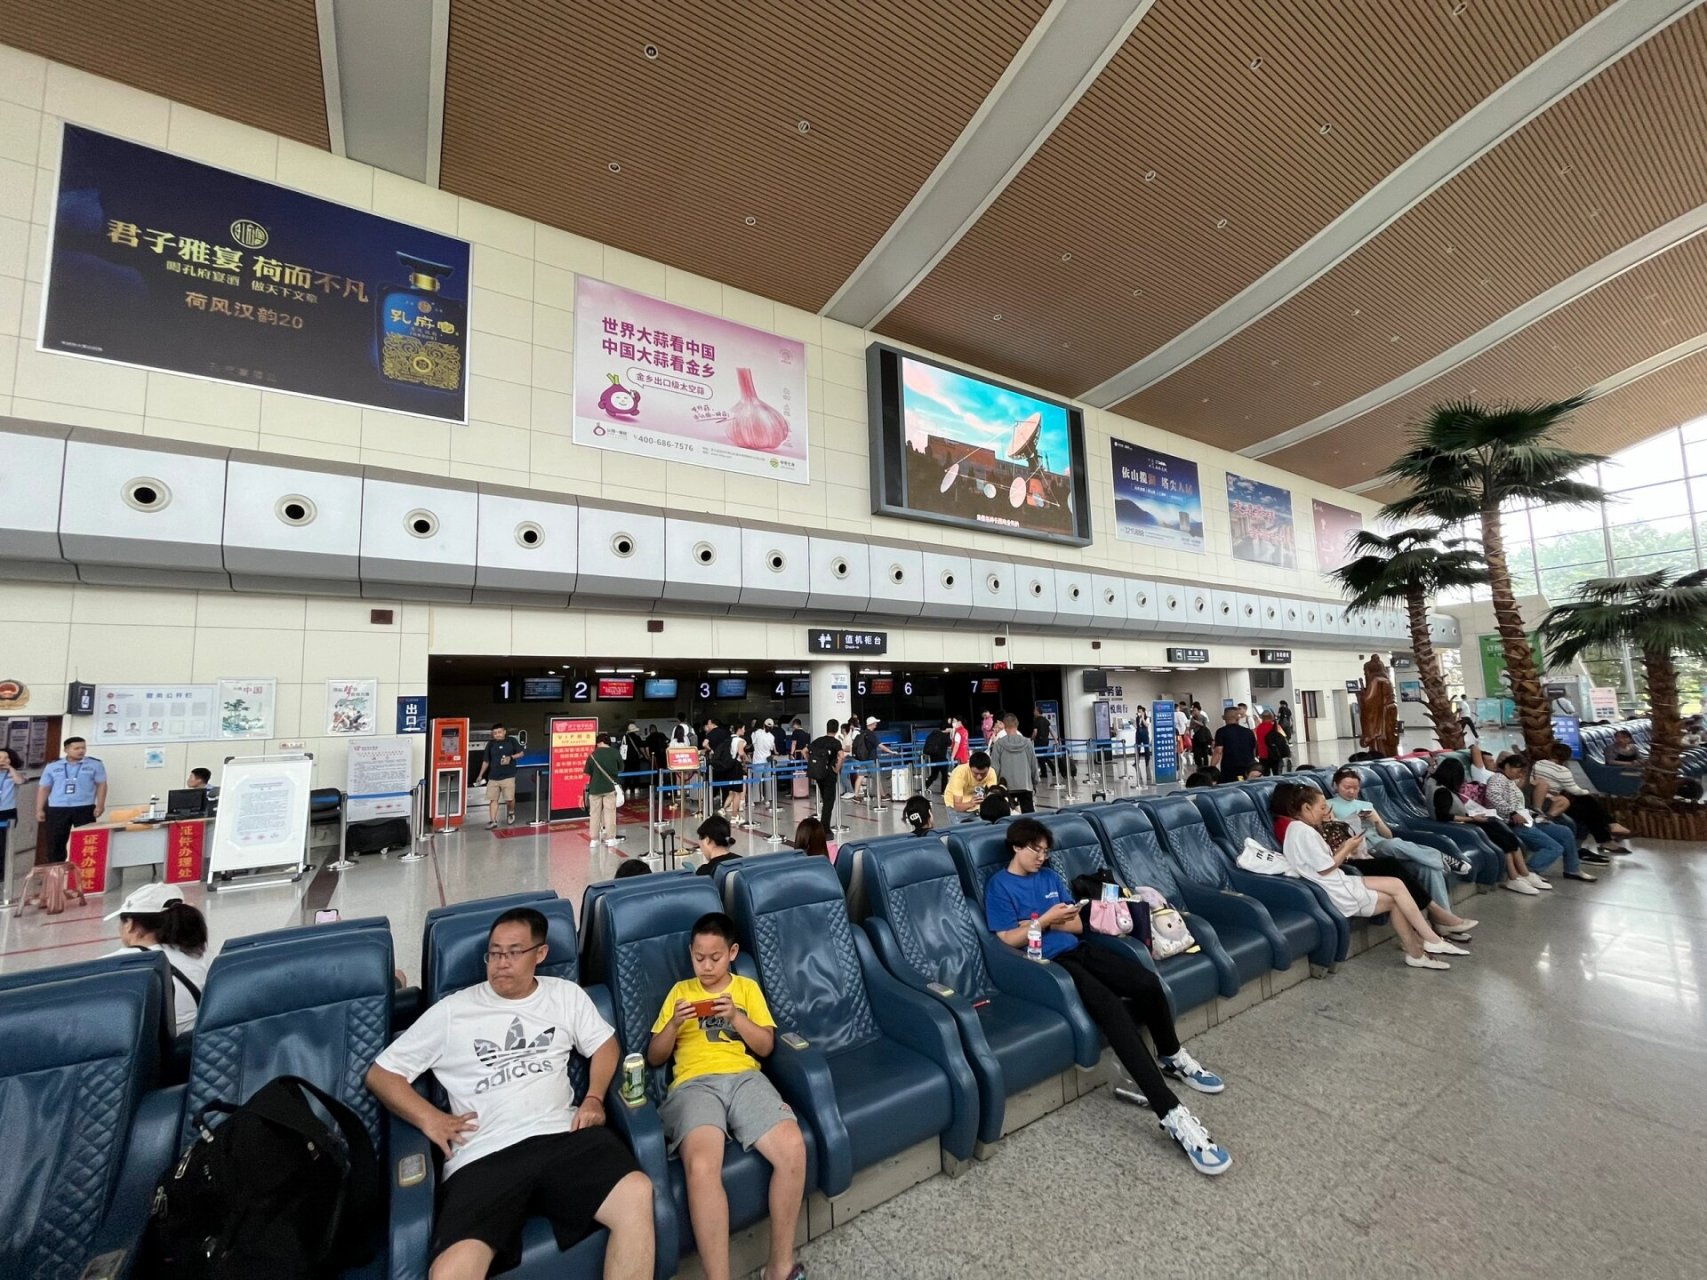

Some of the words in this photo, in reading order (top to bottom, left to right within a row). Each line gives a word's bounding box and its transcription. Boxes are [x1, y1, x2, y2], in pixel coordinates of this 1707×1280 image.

[107, 219, 243, 272] 君子雅宴
[253, 256, 369, 302] 荷而不凡
[166, 261, 240, 286] 喝孔府宴酒
[185, 291, 303, 329] 荷风汉韵20
[602, 317, 715, 361] 世界大蒜看中国
[602, 338, 715, 378] 中国大蒜看金乡
[636, 372, 705, 396] 金乡出口级太空蒜
[638, 436, 694, 452] 400-686-7576
[845, 634, 881, 645] 值机柜台
[501, 681, 509, 699] 1
[575, 682, 587, 698] 2
[700, 683, 710, 698] 3
[775, 681, 785, 696] 4
[858, 681, 866, 695] 5
[904, 682, 912, 695] 6
[971, 681, 978, 693] 7
[405, 703, 418, 726] 出口
[80, 834, 99, 890] 证件办理处
[177, 825, 193, 879] 证件办理处
[474, 1061, 553, 1094] adidas
